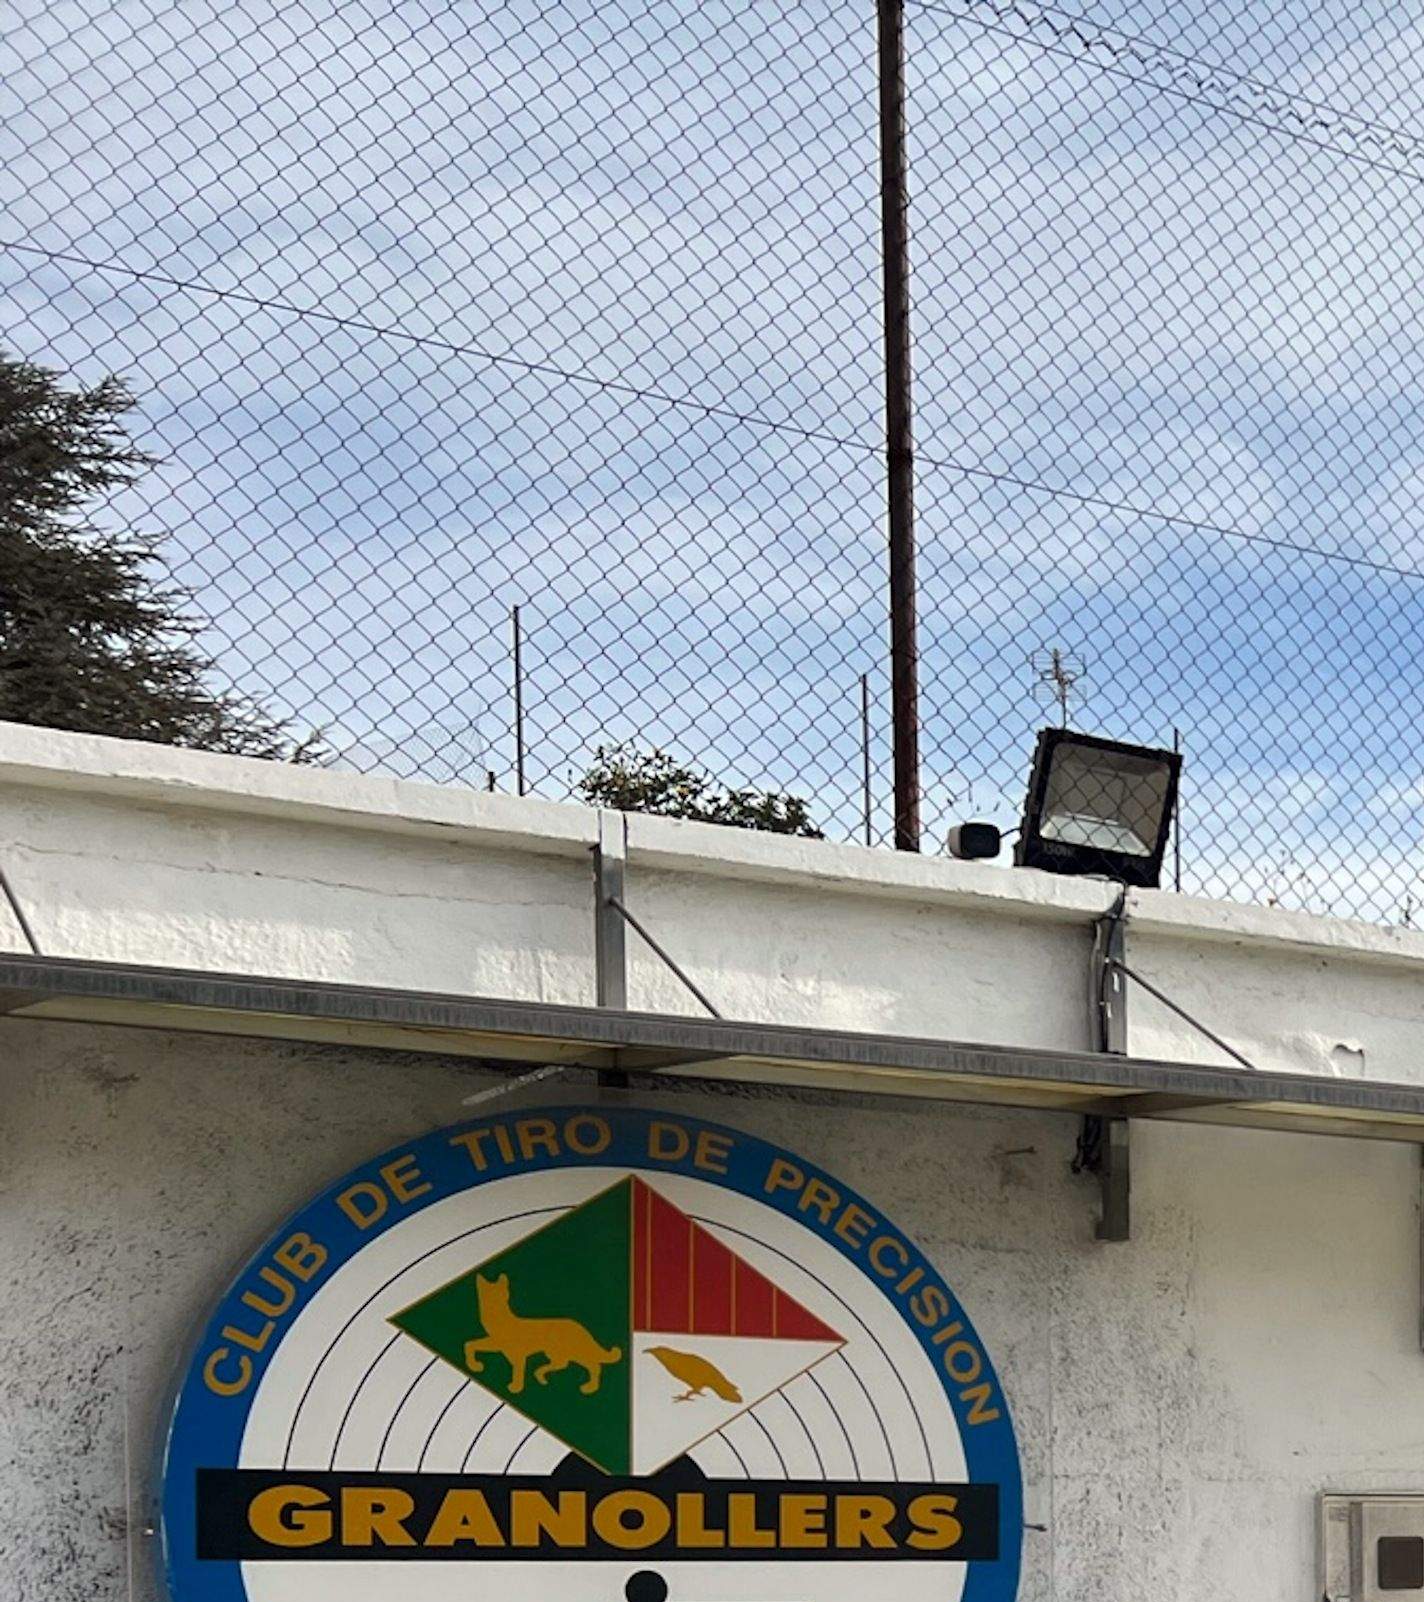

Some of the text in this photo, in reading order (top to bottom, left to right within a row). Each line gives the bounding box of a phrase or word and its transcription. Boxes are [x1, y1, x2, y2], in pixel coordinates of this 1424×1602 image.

[203, 1114, 1000, 1426] CLUB DE TIRO DE PRECISION
[247, 1484, 963, 1550] GRANOLLERS
